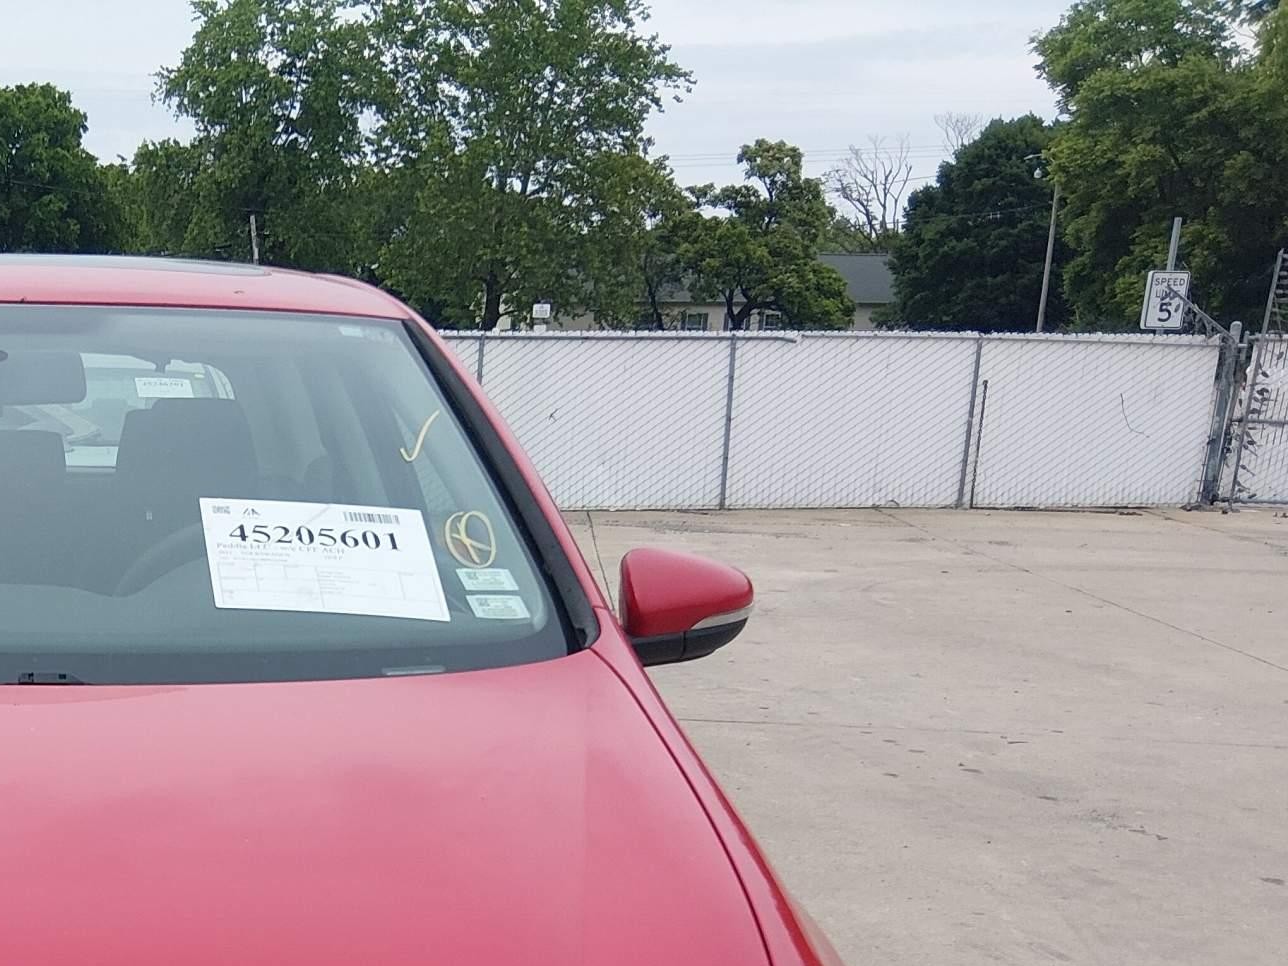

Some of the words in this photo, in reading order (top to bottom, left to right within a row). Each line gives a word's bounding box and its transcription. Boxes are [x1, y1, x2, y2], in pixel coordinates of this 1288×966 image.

[1154, 277, 1186, 287] SPEED
[1157, 301, 1172, 323] 5
[228, 523, 402, 552] 45205601
